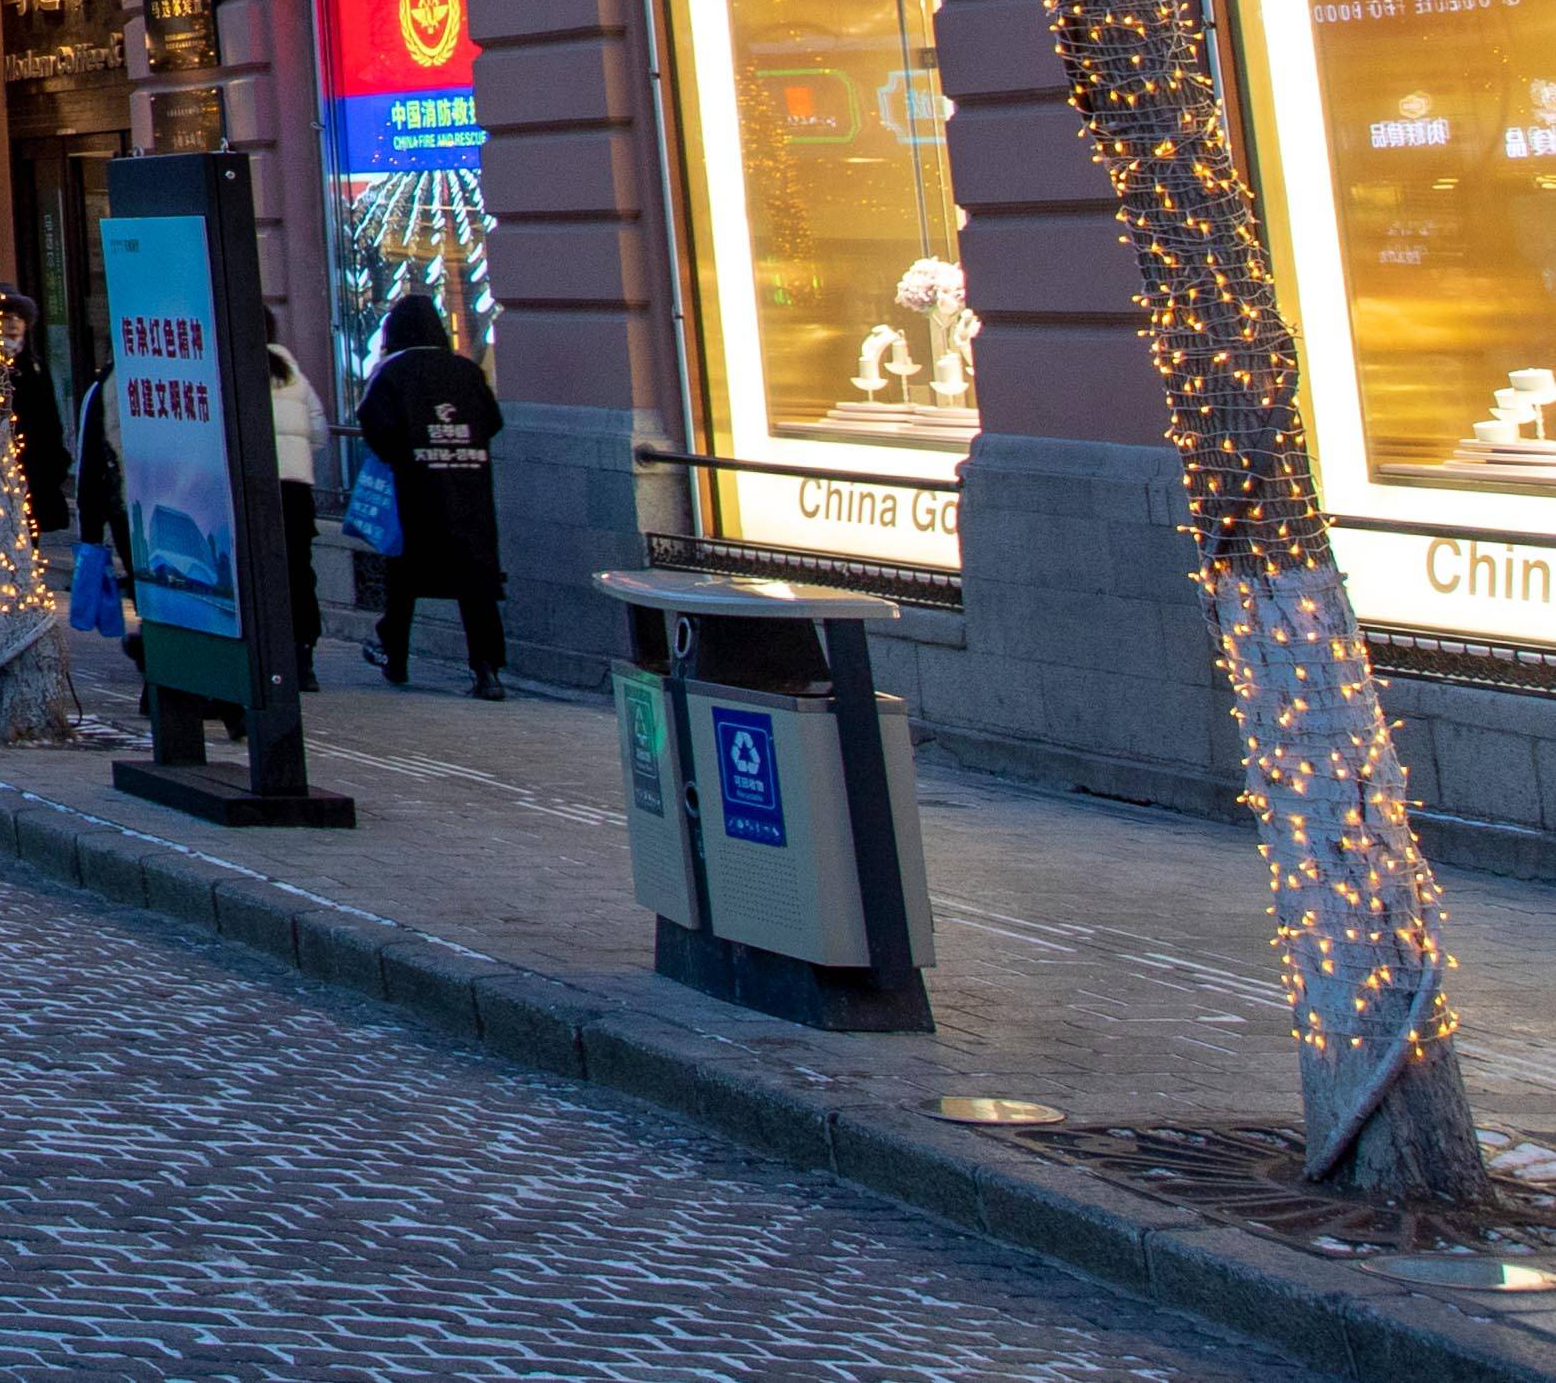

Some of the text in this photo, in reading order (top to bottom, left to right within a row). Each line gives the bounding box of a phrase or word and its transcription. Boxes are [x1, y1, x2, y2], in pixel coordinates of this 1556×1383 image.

[393, 129, 487, 151] CHINA FIRE AND RESCUE
[121, 316, 204, 361] 传承红色精神
[127, 377, 210, 423] 创建文明城市
[799, 477, 898, 528] China
[1425, 535, 1551, 604] Chin
